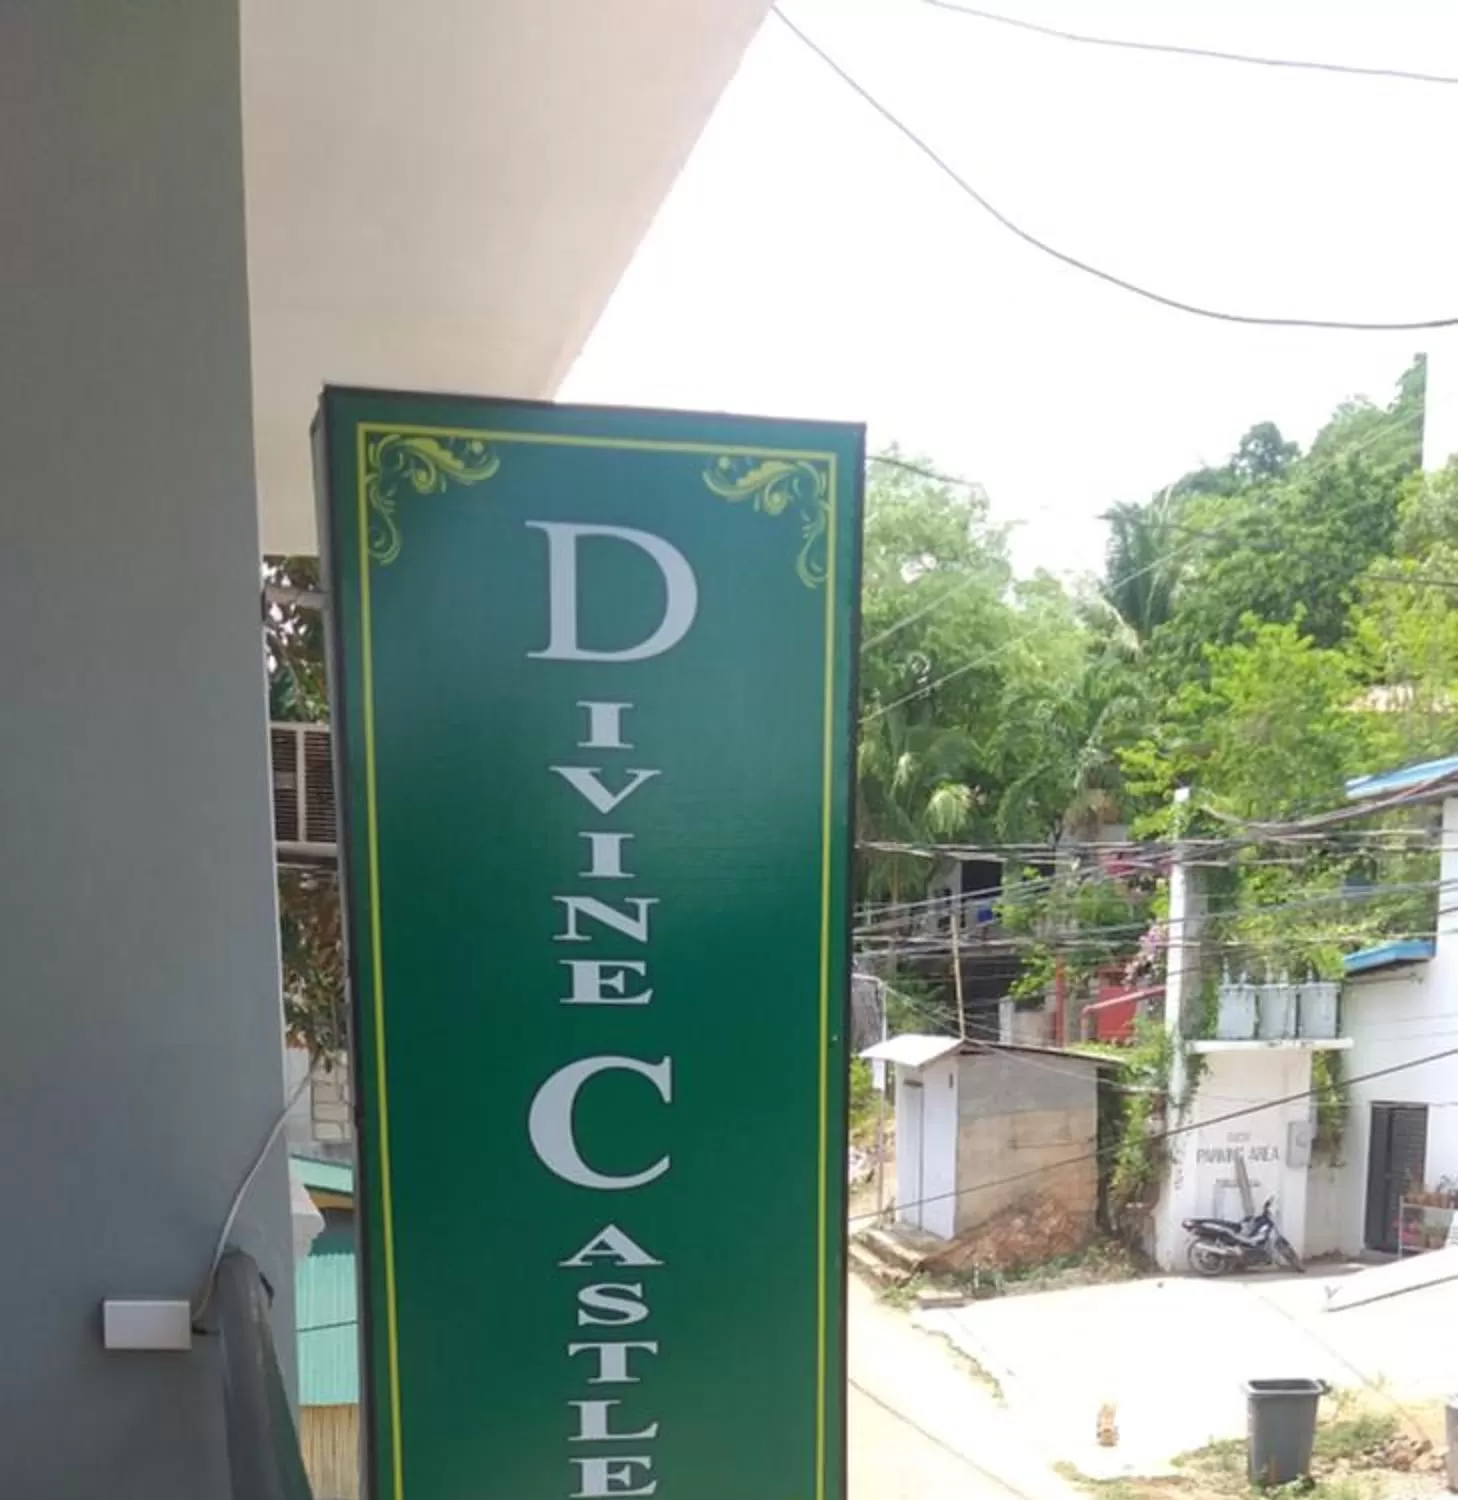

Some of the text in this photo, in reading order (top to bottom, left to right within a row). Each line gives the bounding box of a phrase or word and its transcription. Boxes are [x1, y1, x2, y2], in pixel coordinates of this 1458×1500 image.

[526, 521, 698, 1498] DIVINE CASTLE
[1247, 1145, 1280, 1162] AREA
